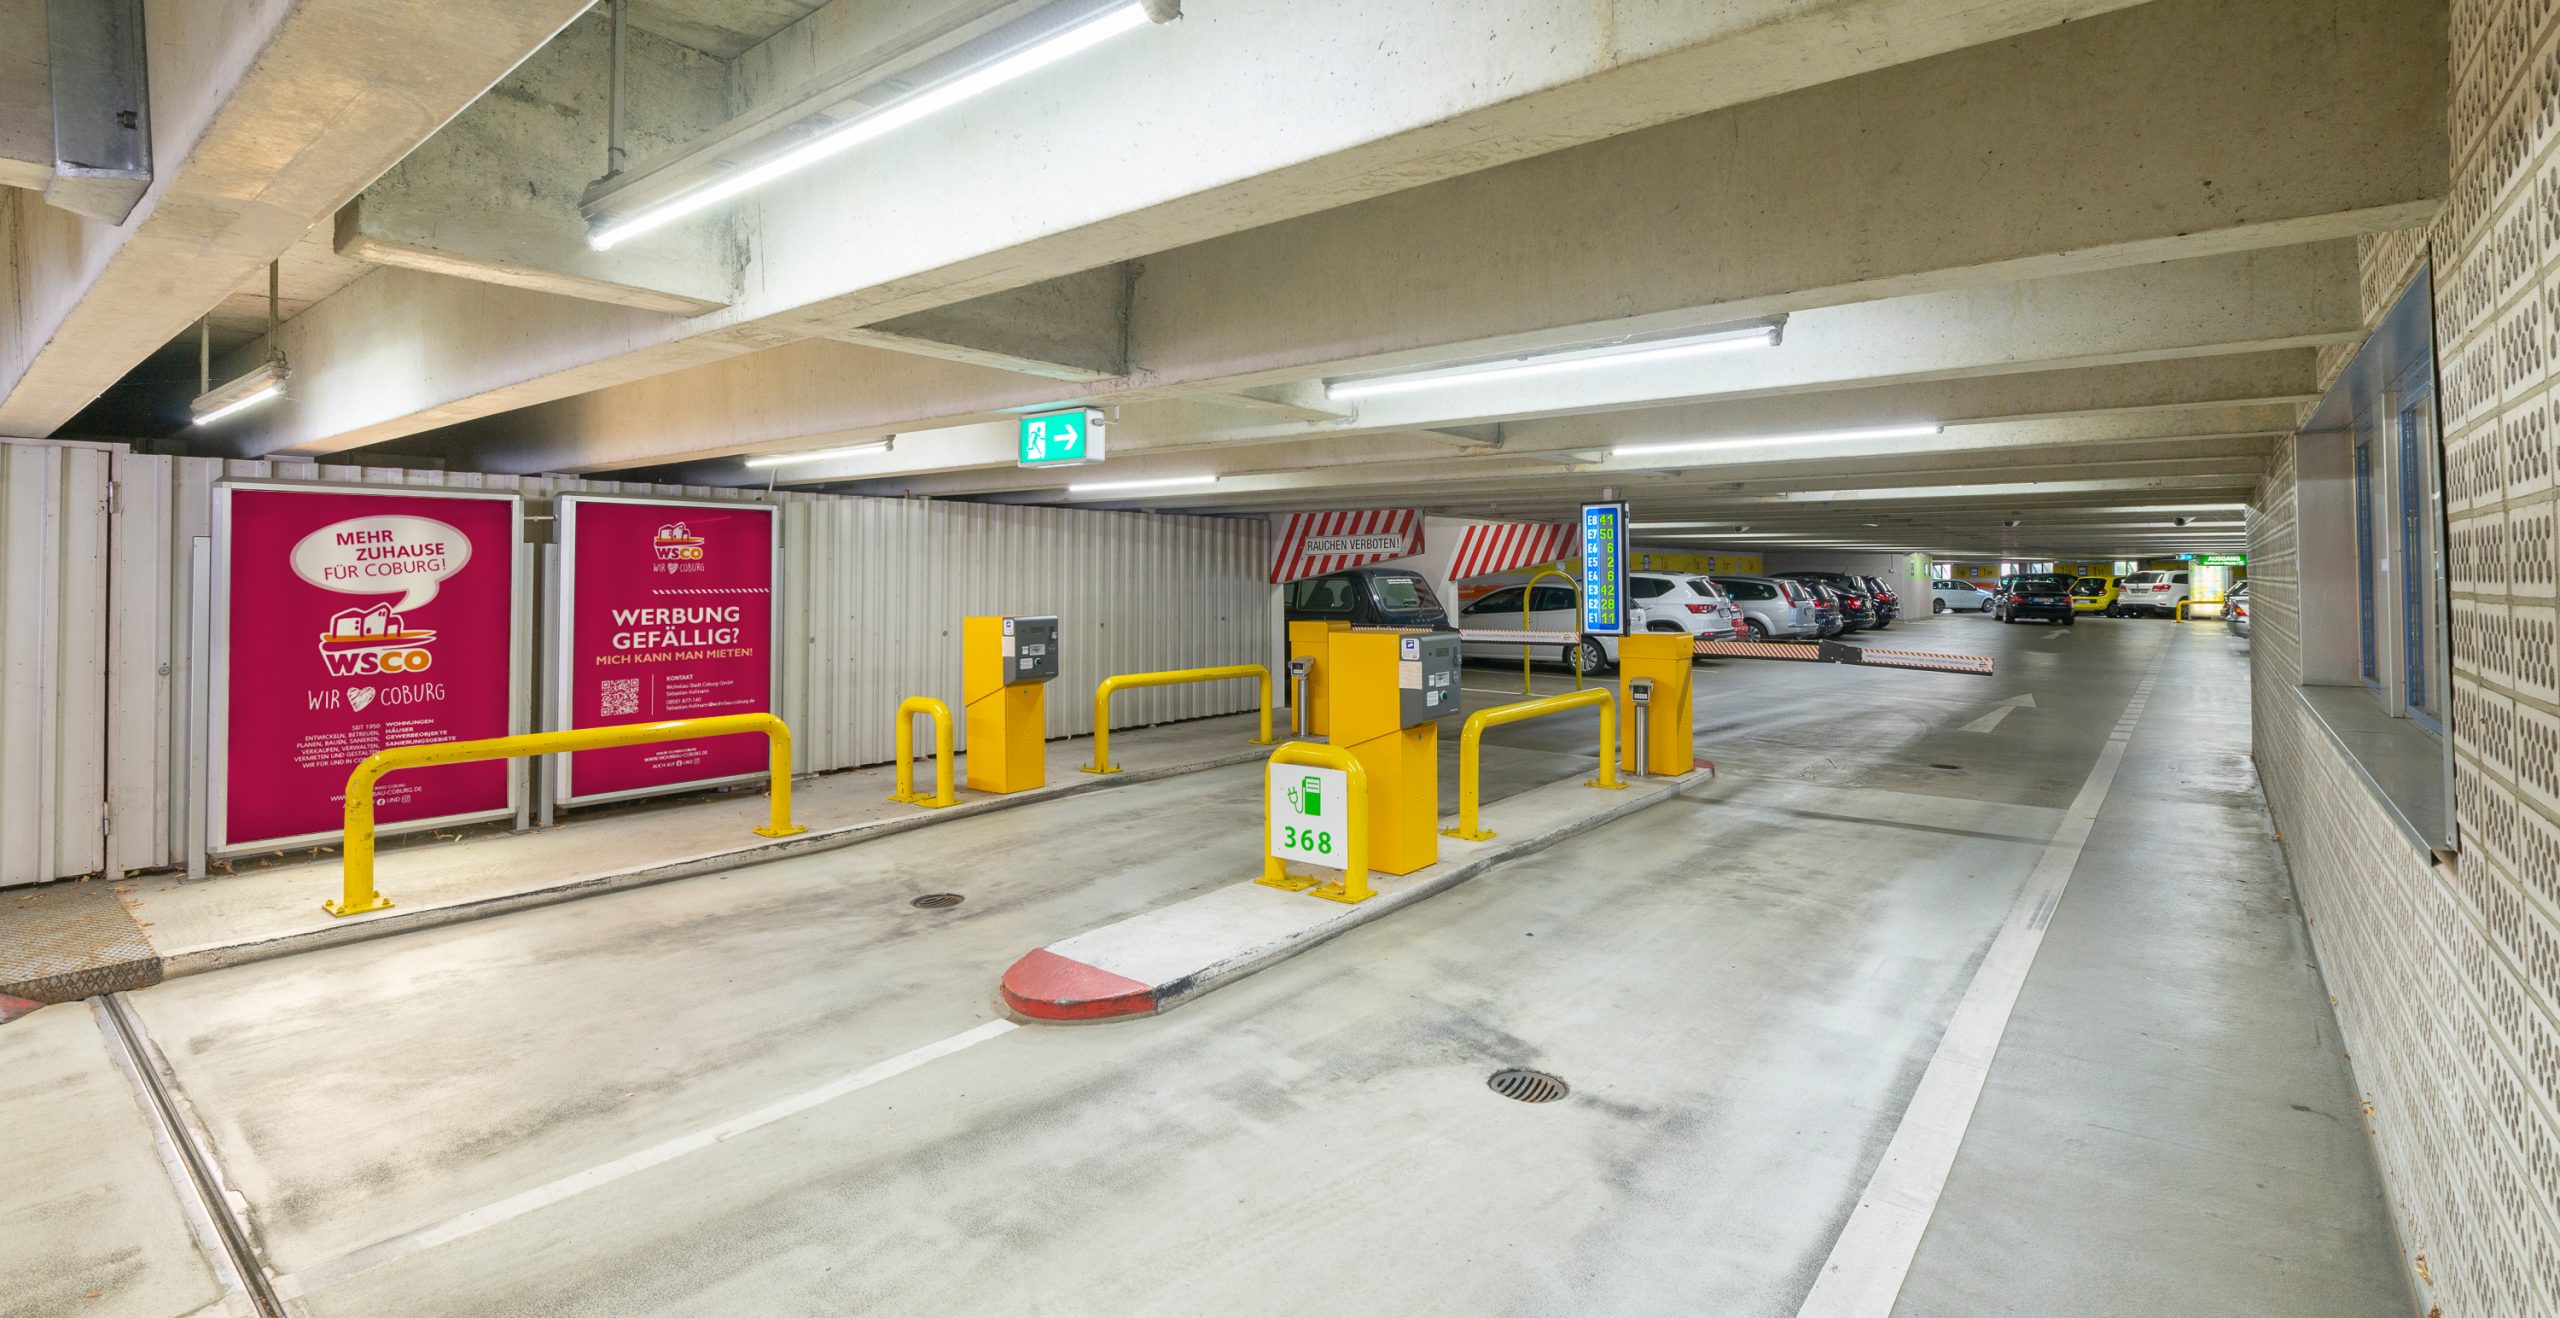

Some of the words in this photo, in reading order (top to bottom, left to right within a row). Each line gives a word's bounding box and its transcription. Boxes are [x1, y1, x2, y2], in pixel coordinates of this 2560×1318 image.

[1587, 515, 1597, 525] E8
[1600, 514, 1613, 525] 41
[336, 530, 393, 546] MEHR
[1588, 529, 1597, 539] E7
[1600, 529, 1614, 539] 50
[1308, 540, 1347, 551] RAUCHEN
[1350, 537, 1399, 550] VERBOTEN!
[1588, 543, 1598, 553] E6
[1607, 543, 1614, 553] 6
[356, 543, 445, 561] ZUHAUSE
[656, 547, 702, 560] WSCO
[653, 563, 665, 572] WIR
[680, 563, 704, 572] COBURG
[1588, 557, 1598, 567] E5
[1608, 557, 1614, 567] 2
[324, 564, 359, 580] FÜR
[365, 558, 446, 577] COBURG!
[1588, 571, 1598, 581] E4
[1608, 571, 1614, 581] 6
[1588, 585, 1598, 595] E3
[1601, 585, 1614, 595] 42
[1589, 599, 1598, 609] E2
[1601, 599, 1614, 609] 28
[612, 606, 740, 626] WERBUNG
[1589, 613, 1598, 623] E1
[1602, 613, 1615, 624] 11
[613, 626, 739, 649] GEFÄLLIG?
[596, 654, 631, 665] MICH
[634, 652, 672, 663] KANN
[675, 650, 703, 661] MAN
[707, 648, 753, 659] MIETEN!
[326, 650, 430, 675] WSCO
[308, 690, 340, 710] WIR
[380, 682, 446, 705] COBURG
[385, 719, 434, 727] WOHNUNGEN
[385, 730, 447, 740] GEWERBEOBJEKTE
[385, 736, 456, 747] SANIERUNGSGEBIETE
[294, 754, 329, 762] VERMIETEN
[1285, 826, 1331, 854] 368
